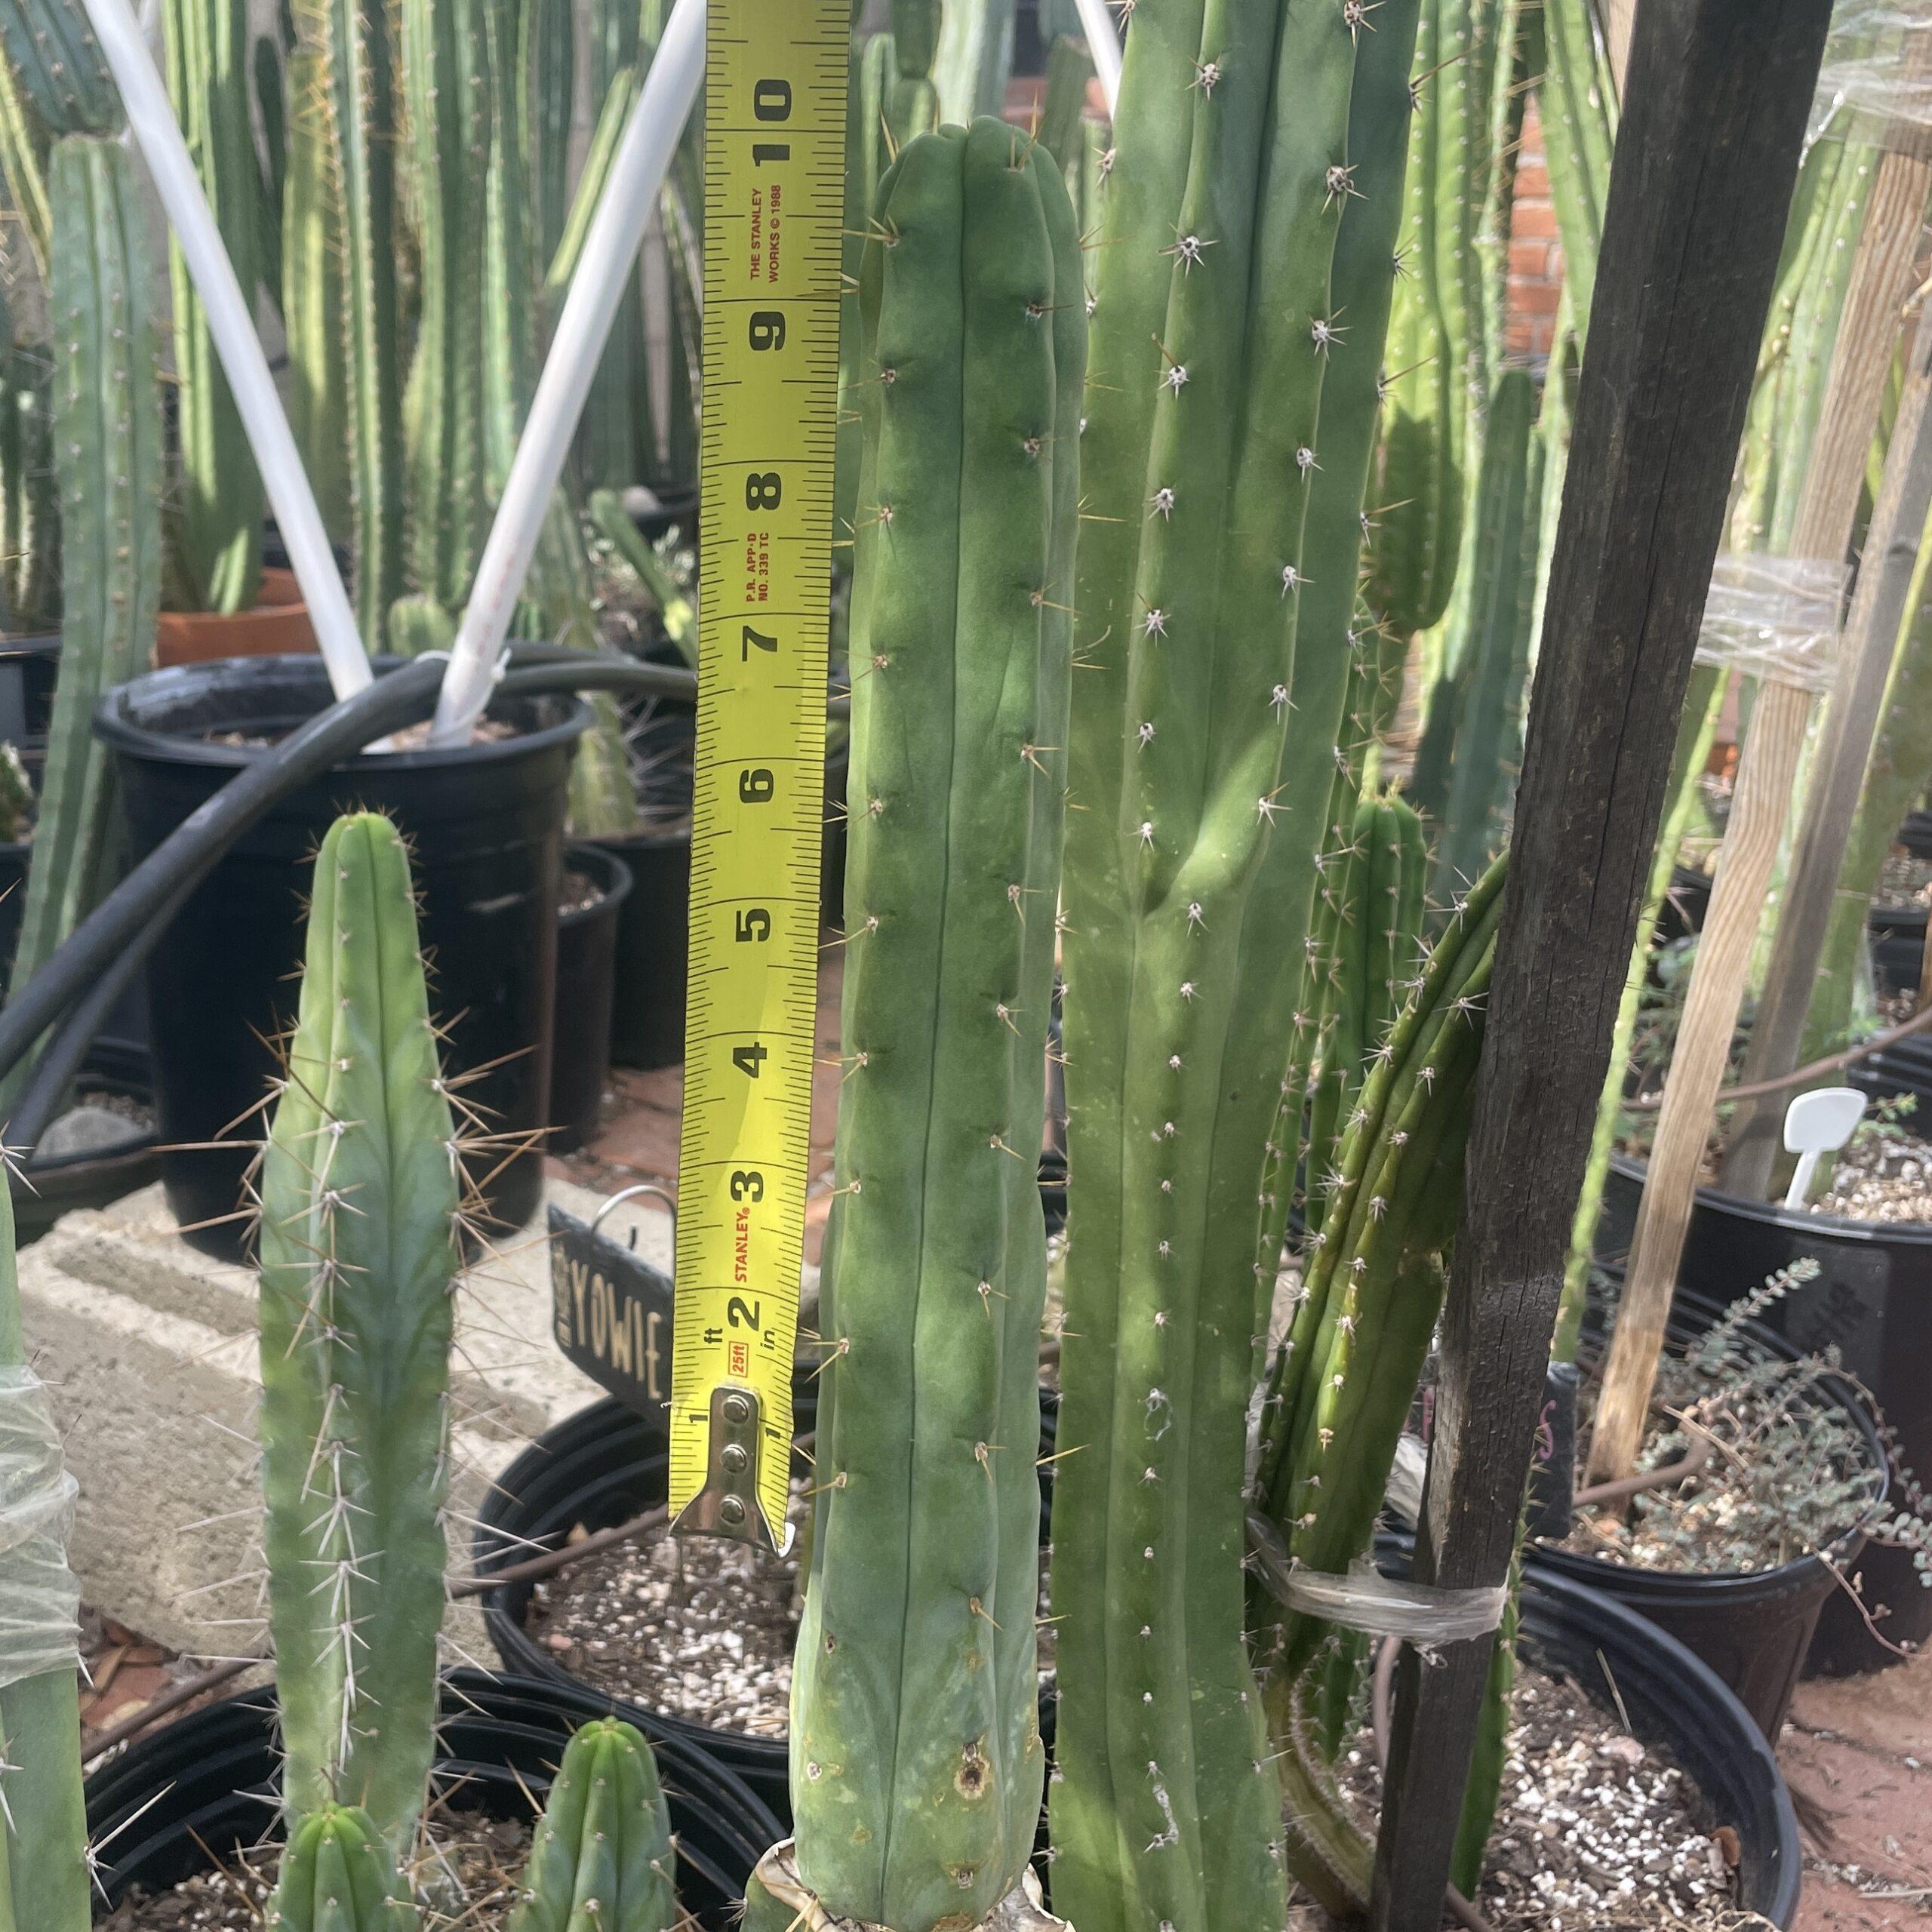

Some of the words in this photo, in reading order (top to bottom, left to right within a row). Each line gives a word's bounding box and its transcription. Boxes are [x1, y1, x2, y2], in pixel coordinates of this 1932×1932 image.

[752, 78, 792, 167] 10
[771, 184, 782, 214] 1988
[751, 188, 762, 249] STANLEY
[750, 253, 761, 280] THE
[769, 232, 780, 283] WORKS
[749, 311, 786, 351] 9
[746, 472, 782, 511] 8
[759, 532, 769, 549] TC
[758, 553, 769, 576] 339
[742, 625, 777, 662] 7
[739, 768, 774, 804] 6
[735, 909, 771, 943] 5
[732, 1041, 768, 1078] 4
[731, 1171, 764, 1203] 3
[728, 1297, 760, 1332] 2
[703, 1327, 723, 1344] ft
[760, 1329, 776, 1350] in
[732, 1344, 745, 1373] 25ft
[689, 1414, 709, 1423] 1
[765, 1427, 782, 1440] 1
